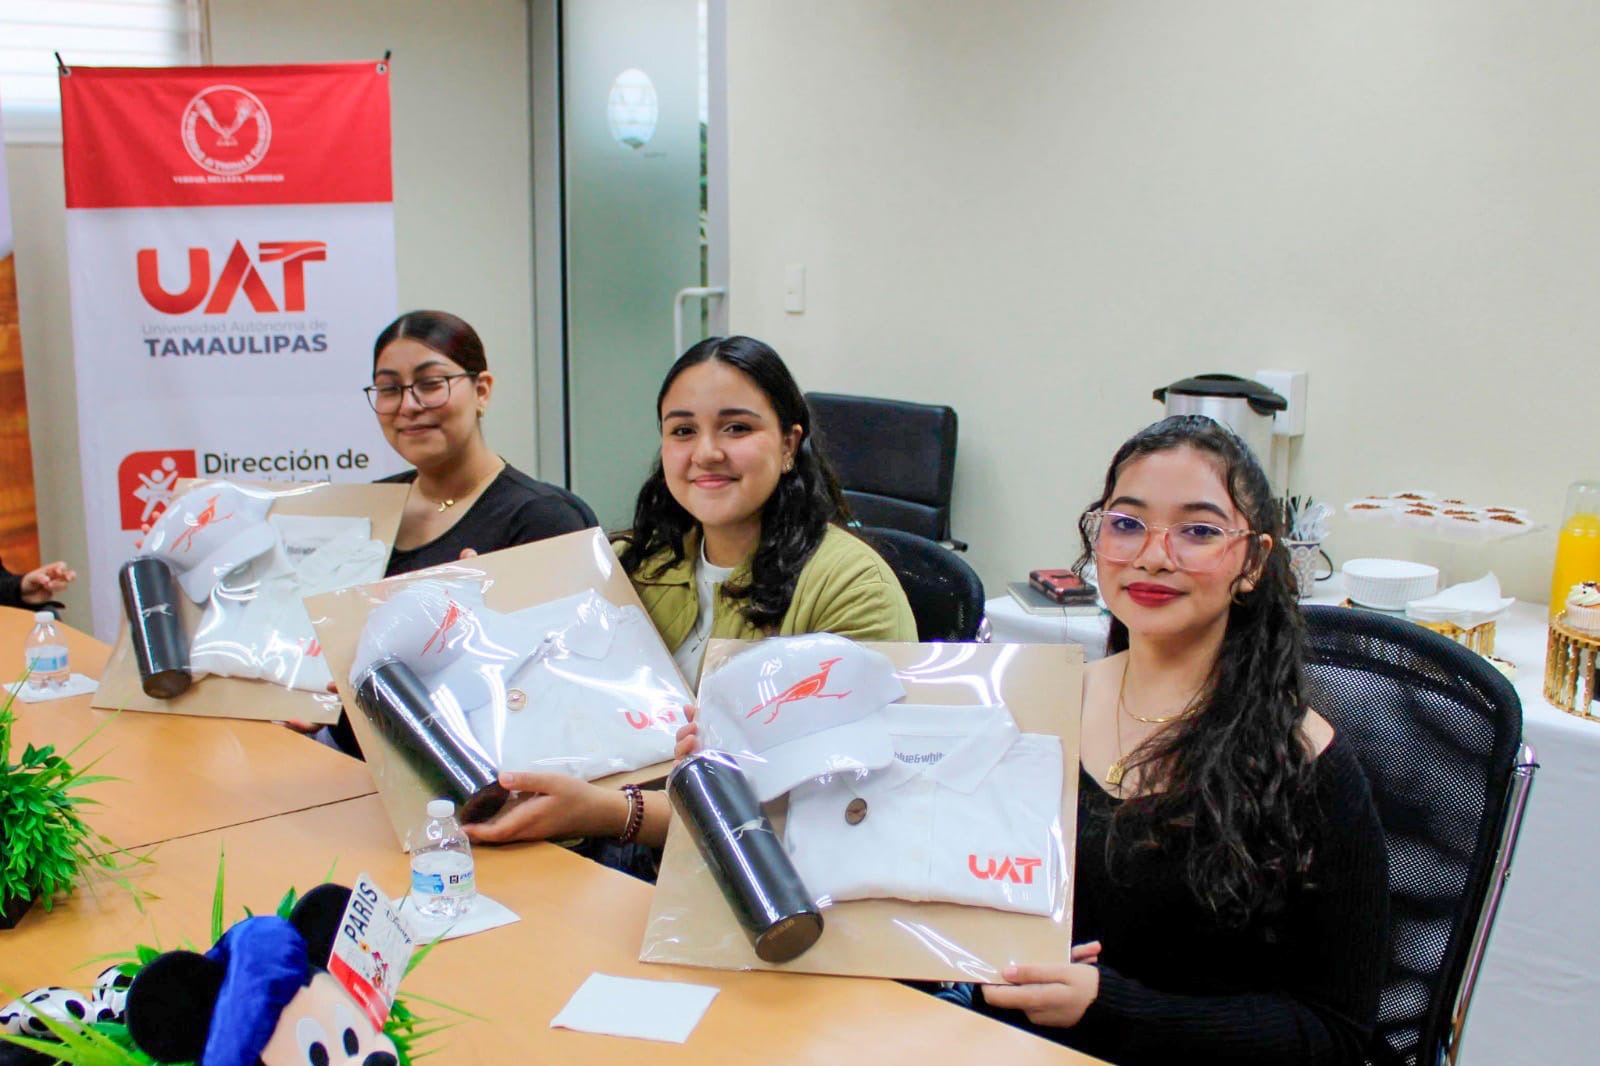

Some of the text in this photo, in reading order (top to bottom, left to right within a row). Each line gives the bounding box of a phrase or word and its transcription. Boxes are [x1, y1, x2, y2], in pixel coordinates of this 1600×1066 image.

[136, 239, 327, 316] UAT
[141, 321, 226, 336] Universidad
[309, 318, 328, 331] de
[143, 333, 328, 358] TAMAULIPAS
[203, 448, 369, 475] Dirección de
[968, 853, 1042, 885] UAT
[344, 881, 378, 944] PARIS
